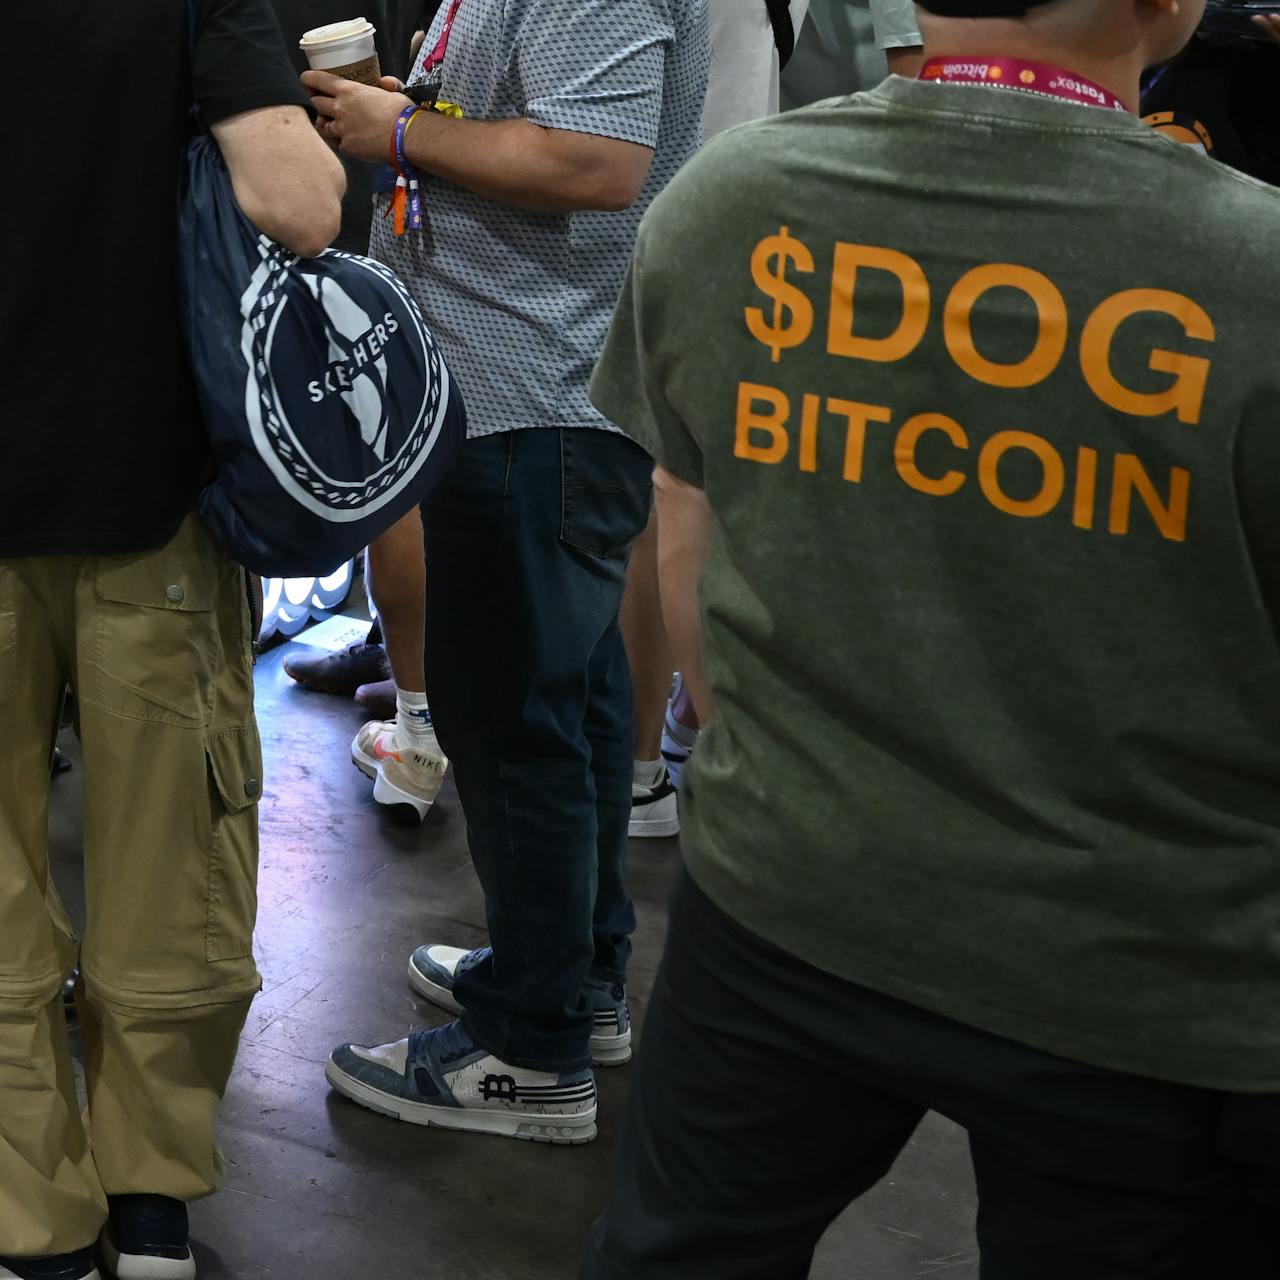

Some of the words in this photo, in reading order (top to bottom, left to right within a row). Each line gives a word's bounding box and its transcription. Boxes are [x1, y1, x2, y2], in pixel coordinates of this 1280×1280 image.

[307, 311, 399, 404] SKEHERS
[743, 225, 1216, 426] $DOG
[733, 380, 1191, 542] BITCOIN
[412, 753, 442, 772] NIKE
